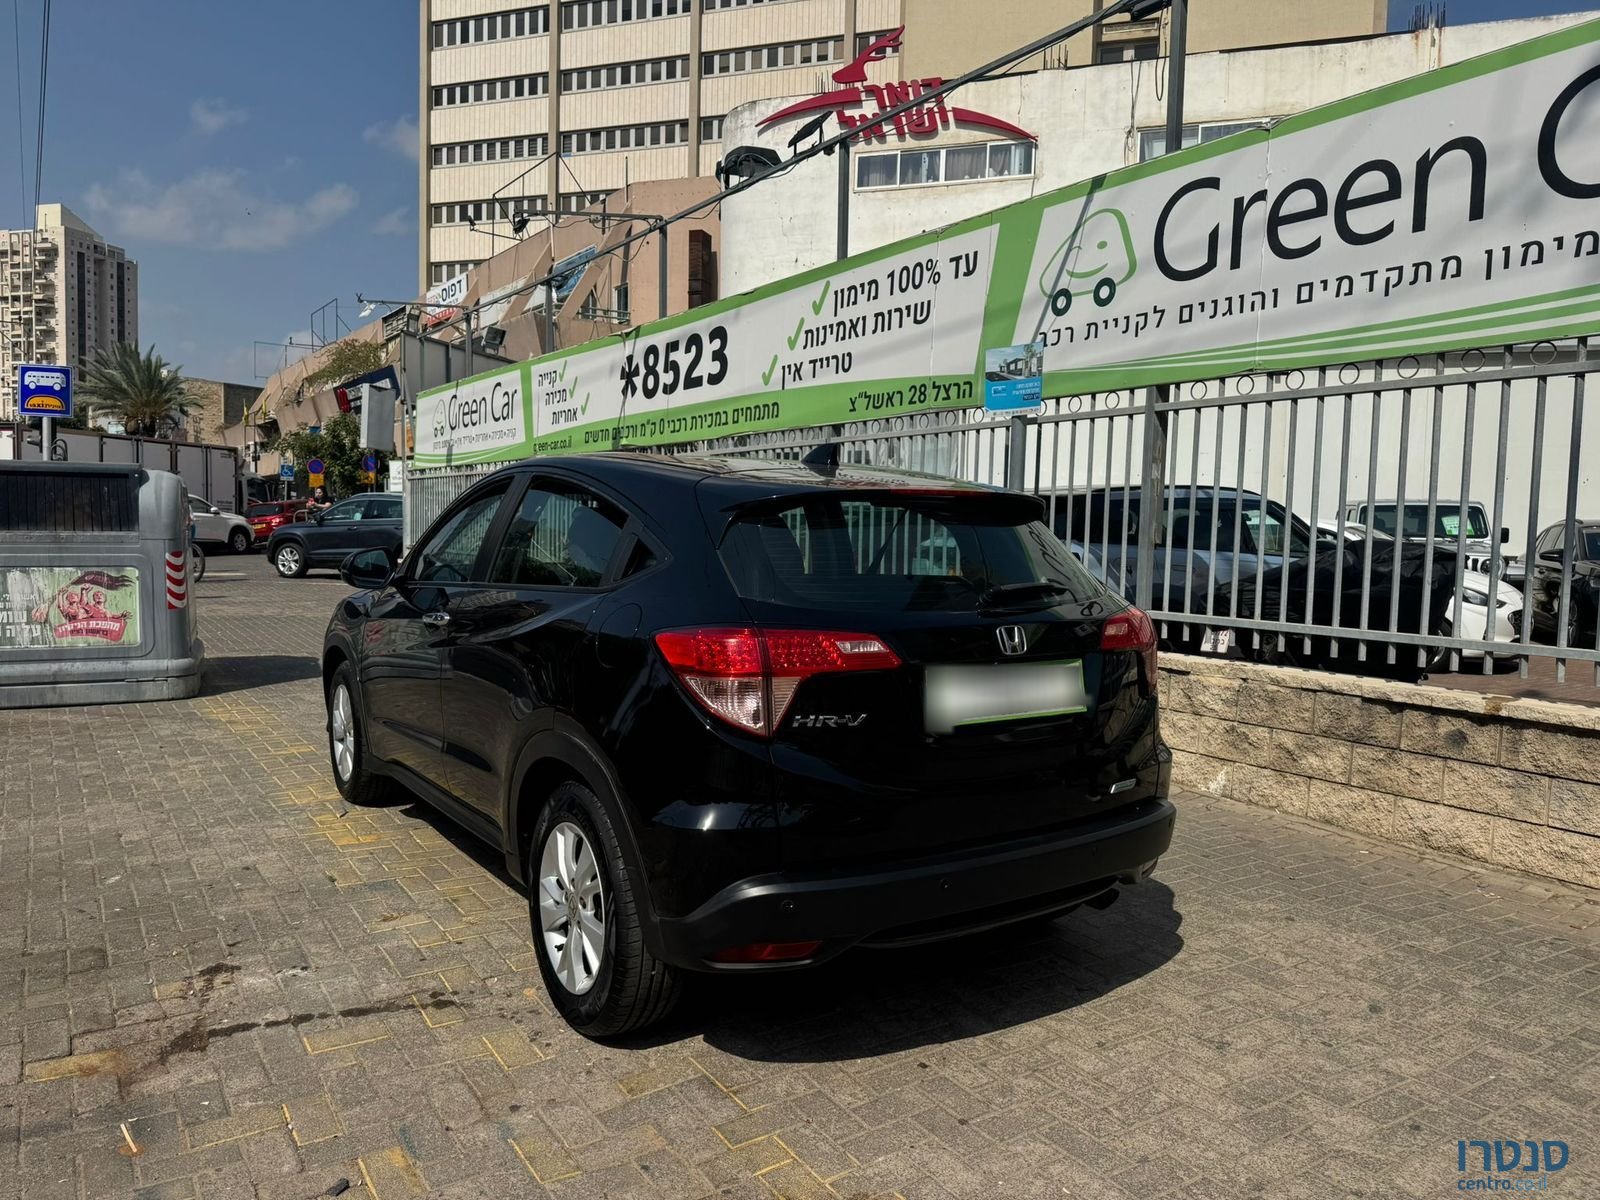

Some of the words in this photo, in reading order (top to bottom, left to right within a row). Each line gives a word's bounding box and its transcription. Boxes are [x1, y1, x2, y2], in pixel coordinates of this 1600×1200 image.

[863, 77, 943, 110] דואר
[836, 105, 949, 141] ישראל
[1153, 136, 1487, 282] Green
[949, 250, 978, 280] עד
[1484, 230, 1600, 281] מימון
[887, 258, 941, 296] 100%
[1297, 255, 1462, 305] מתקדמים
[441, 279, 463, 302] דפוס
[833, 278, 879, 317] מימון
[871, 299, 932, 335] שירות
[1178, 287, 1279, 325] והוגנים
[802, 315, 867, 350] ואמינות
[1084, 305, 1166, 341] לקניית
[1038, 326, 1074, 348] רכב
[781, 361, 804, 391] אין
[808, 351, 853, 379] טרייד
[538, 370, 558, 388] קנייה
[931, 380, 973, 402] הרצל
[448, 394, 488, 431] Green
[491, 382, 518, 422] Car
[545, 388, 567, 406] מכירה
[848, 390, 903, 413] ראשל"צ
[908, 383, 927, 405] 28
[552, 407, 578, 425] אחריות
[658, 418, 665, 434] 0
[667, 417, 688, 434] רכבי
[690, 410, 729, 431] במכירת
[732, 401, 780, 425] מתמחים
[584, 428, 610, 444] חדשים
[640, 418, 656, 437] ק"מ
[791, 713, 869, 728] HR-V
